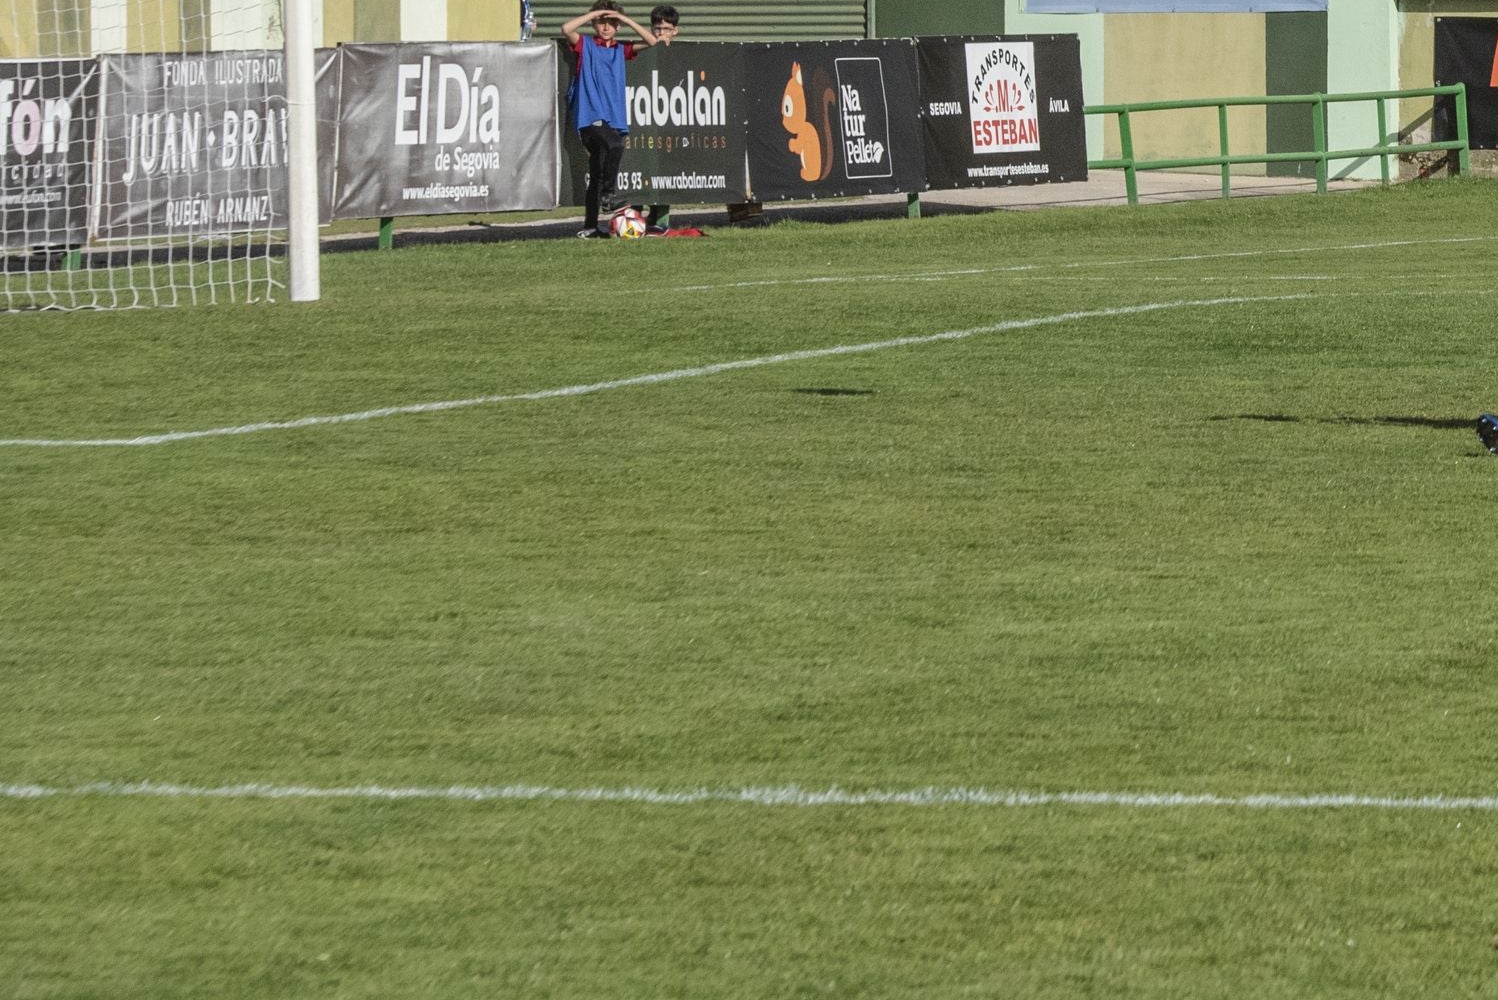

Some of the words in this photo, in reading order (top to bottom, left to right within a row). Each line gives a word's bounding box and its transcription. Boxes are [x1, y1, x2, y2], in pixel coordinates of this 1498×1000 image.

[165, 60, 205, 87] FONDA
[214, 58, 283, 86] ILUSTRADA
[971, 48, 1036, 105] TRANSPORTES
[395, 56, 431, 145] El
[436, 63, 500, 144] Día
[841, 84, 861, 111] Na
[929, 101, 962, 116] SEGOVIA
[1049, 96, 1070, 113] ÁVILA
[843, 112, 866, 137] tur
[973, 118, 1038, 147] ESTEBAN
[122, 112, 201, 186] JUAN
[435, 145, 450, 172] de
[453, 145, 500, 177] Segovia
[617, 172, 629, 190] 03
[631, 172, 643, 190] 93
[651, 171, 727, 190] www.rabalan.com
[967, 161, 1050, 178] www.transportesesteban.es
[402, 182, 489, 201] www.eldiasegovia.es
[165, 192, 209, 227] RUBÉN
[216, 195, 268, 224] ARNANZ
